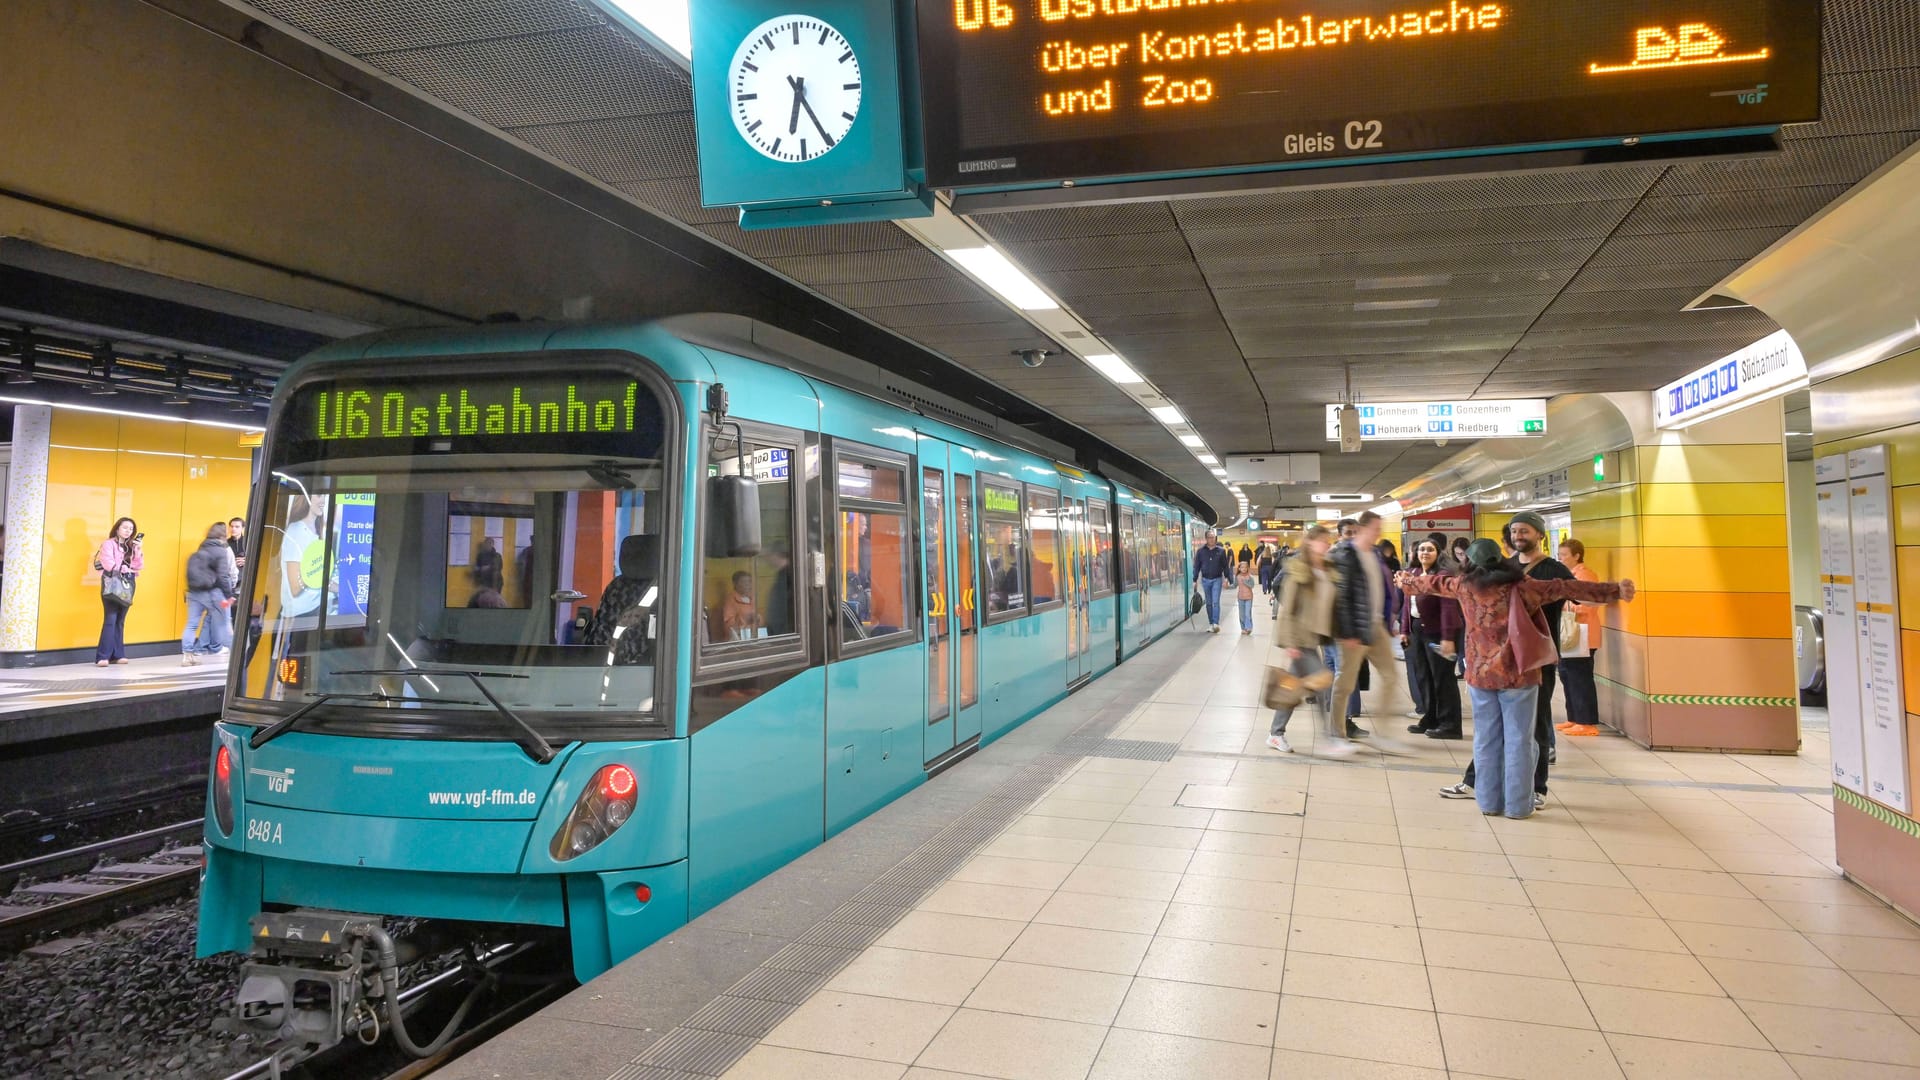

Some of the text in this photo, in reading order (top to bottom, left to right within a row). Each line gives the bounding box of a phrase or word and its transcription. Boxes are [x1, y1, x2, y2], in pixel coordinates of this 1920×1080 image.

[1042, 41, 1128, 72] über
[1141, 2, 1501, 63] Konstablerwache
[1045, 75, 1212, 114] und Zoo
[1737, 84, 1768, 104] VGF
[1284, 120, 1383, 154] Gleis C2
[959, 161, 997, 172] LUMINO
[1741, 342, 1789, 383] Südbahnhof
[318, 383, 637, 439] U6 Ostbahnhof
[1377, 408, 1418, 417] Ginnheim
[1456, 405, 1511, 415] Gonzenheim
[1378, 424, 1422, 433] Hohemark
[1458, 423, 1498, 434] Riedberg
[347, 533, 373, 544] FLUG
[280, 659, 297, 683] 02
[269, 768, 295, 793] VGF
[429, 789, 536, 808] www.vgf-ffm.de
[247, 819, 282, 844] 848 A
